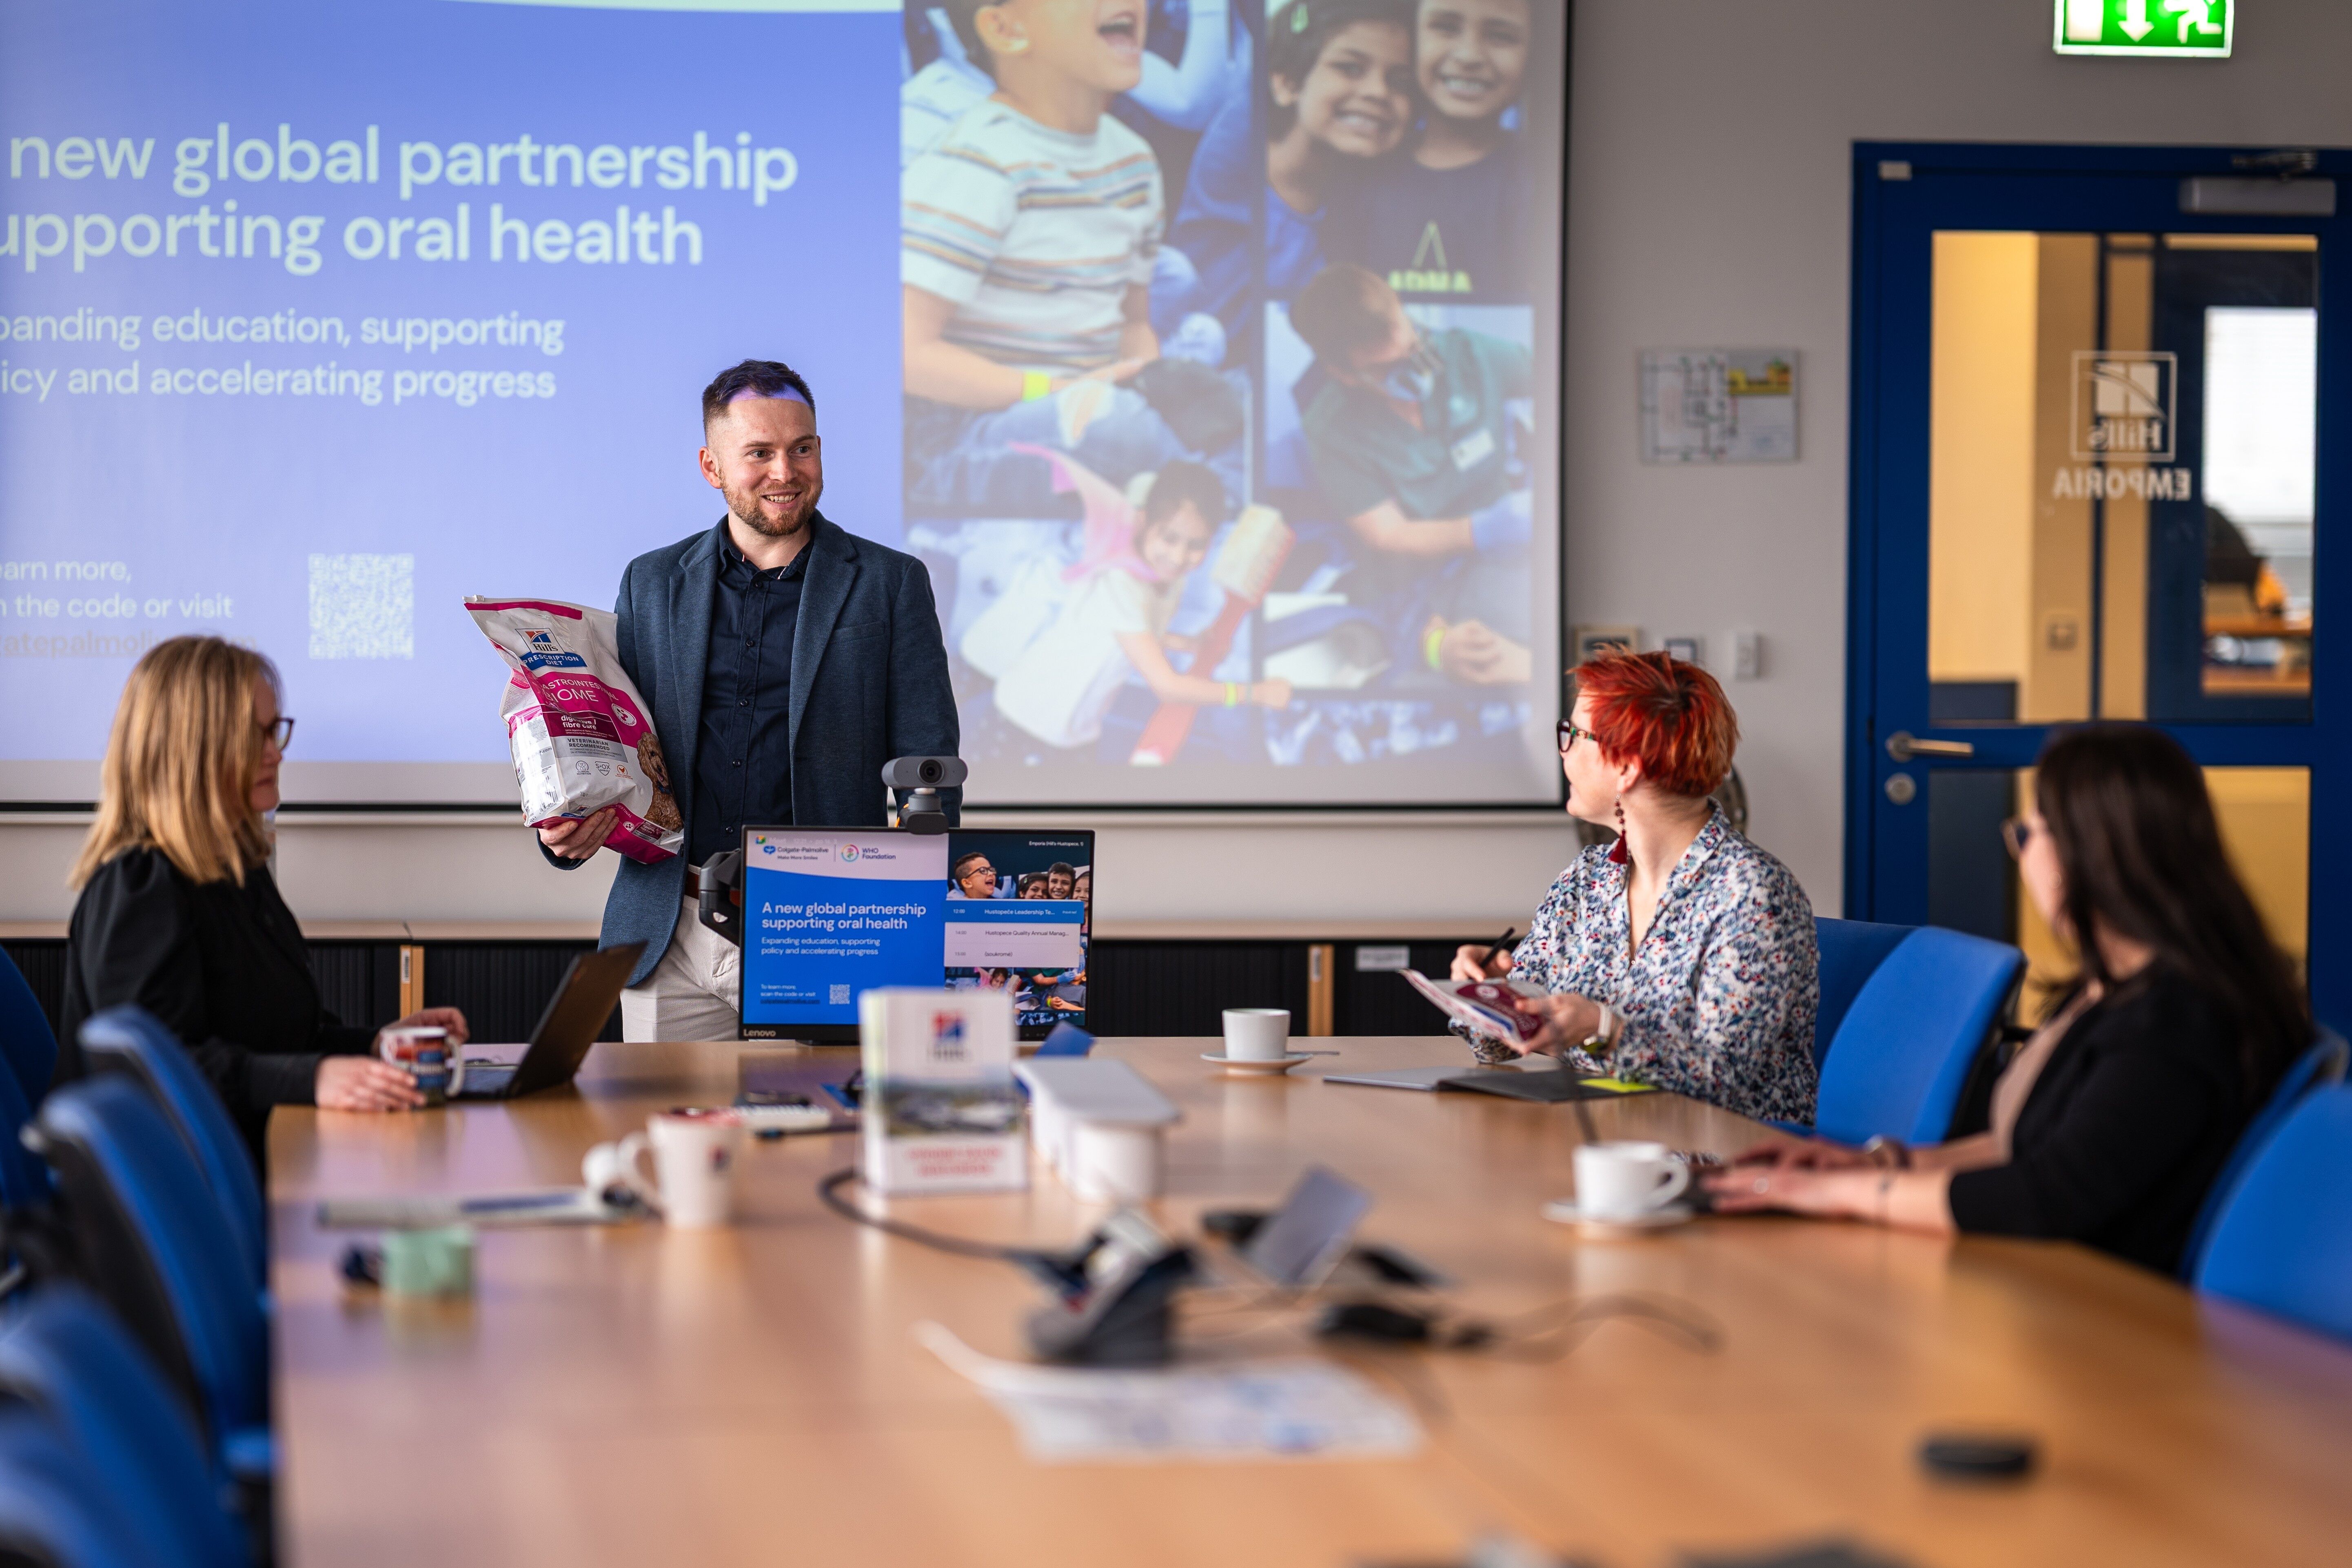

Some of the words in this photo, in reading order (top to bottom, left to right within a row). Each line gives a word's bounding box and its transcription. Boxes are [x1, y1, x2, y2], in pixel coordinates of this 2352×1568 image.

[11, 136, 156, 180] new
[173, 122, 379, 197] global
[399, 130, 799, 207] partnership
[344, 202, 470, 261] oral
[490, 203, 703, 265] health
[152, 307, 351, 348] education,
[360, 310, 566, 356] supporting
[68, 359, 140, 395] and
[150, 359, 384, 406] accelerating
[394, 369, 556, 407] progress
[0, 561, 47, 581] arn
[54, 561, 131, 583] more,
[15, 593, 60, 618] the
[67, 593, 137, 618] code
[144, 597, 172, 618] or
[178, 593, 233, 618] visit
[533, 643, 559, 652] Hill's
[524, 654, 579, 664] PRESCRIPTION
[567, 738, 608, 746] VETERINARIAN
[762, 902, 772, 914] A
[775, 904, 803, 914] new
[805, 902, 846, 917] global
[848, 903, 927, 918] partnership
[762, 917, 835, 932] supporting
[837, 917, 863, 929] oral
[865, 917, 908, 929] health
[761, 937, 800, 946] Expanding
[801, 937, 840, 945] education,
[841, 938, 881, 947] supporting
[761, 947, 784, 956] policy
[801, 947, 845, 957] accelerating
[846, 948, 879, 957] progress
[743, 1028, 776, 1037] Lenovo
